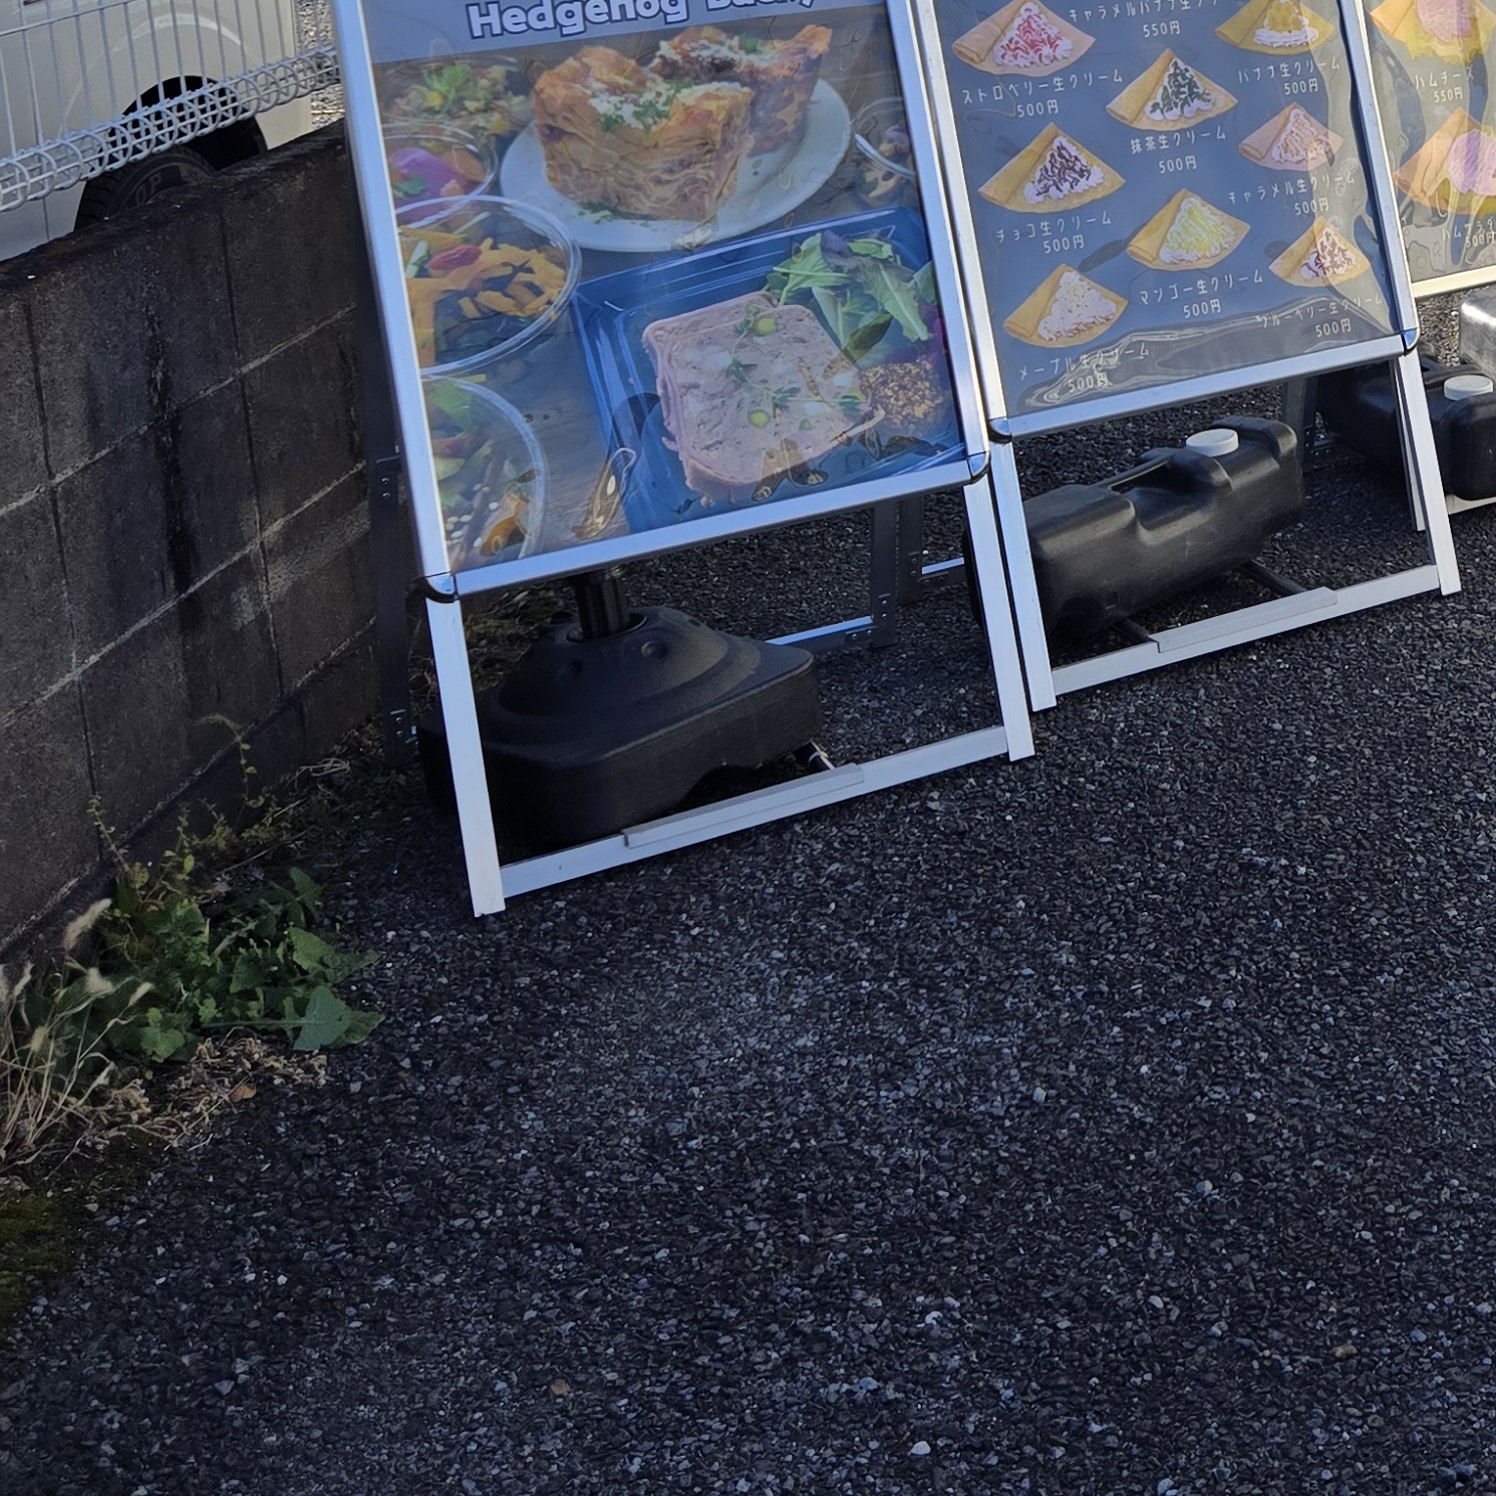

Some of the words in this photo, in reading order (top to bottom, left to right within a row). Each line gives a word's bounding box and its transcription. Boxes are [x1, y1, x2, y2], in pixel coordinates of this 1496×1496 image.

[1142, 20, 1181, 38] 550円
[1238, 59, 1340, 83] バナナ生クリーム
[1415, 66, 1474, 89] ハムチーズ
[962, 68, 1123, 104] ストロベリー生クリーム
[1284, 78, 1319, 96] 500円
[1433, 86, 1463, 103] 550円
[1016, 100, 1059, 118] 500円
[1130, 127, 1226, 154] 抹茶生クリーム
[1158, 156, 1197, 174] 500円
[1228, 170, 1355, 204] キャラメル生クリーム
[1294, 197, 1329, 216] 500円
[996, 212, 1112, 243] チョコ生クリーム
[1043, 236, 1085, 254] 500円
[1140, 270, 1264, 304] マンゴー生クリーム
[1183, 300, 1222, 319] 500円
[1315, 317, 1352, 338] 500円
[1068, 372, 1109, 393] 500円
